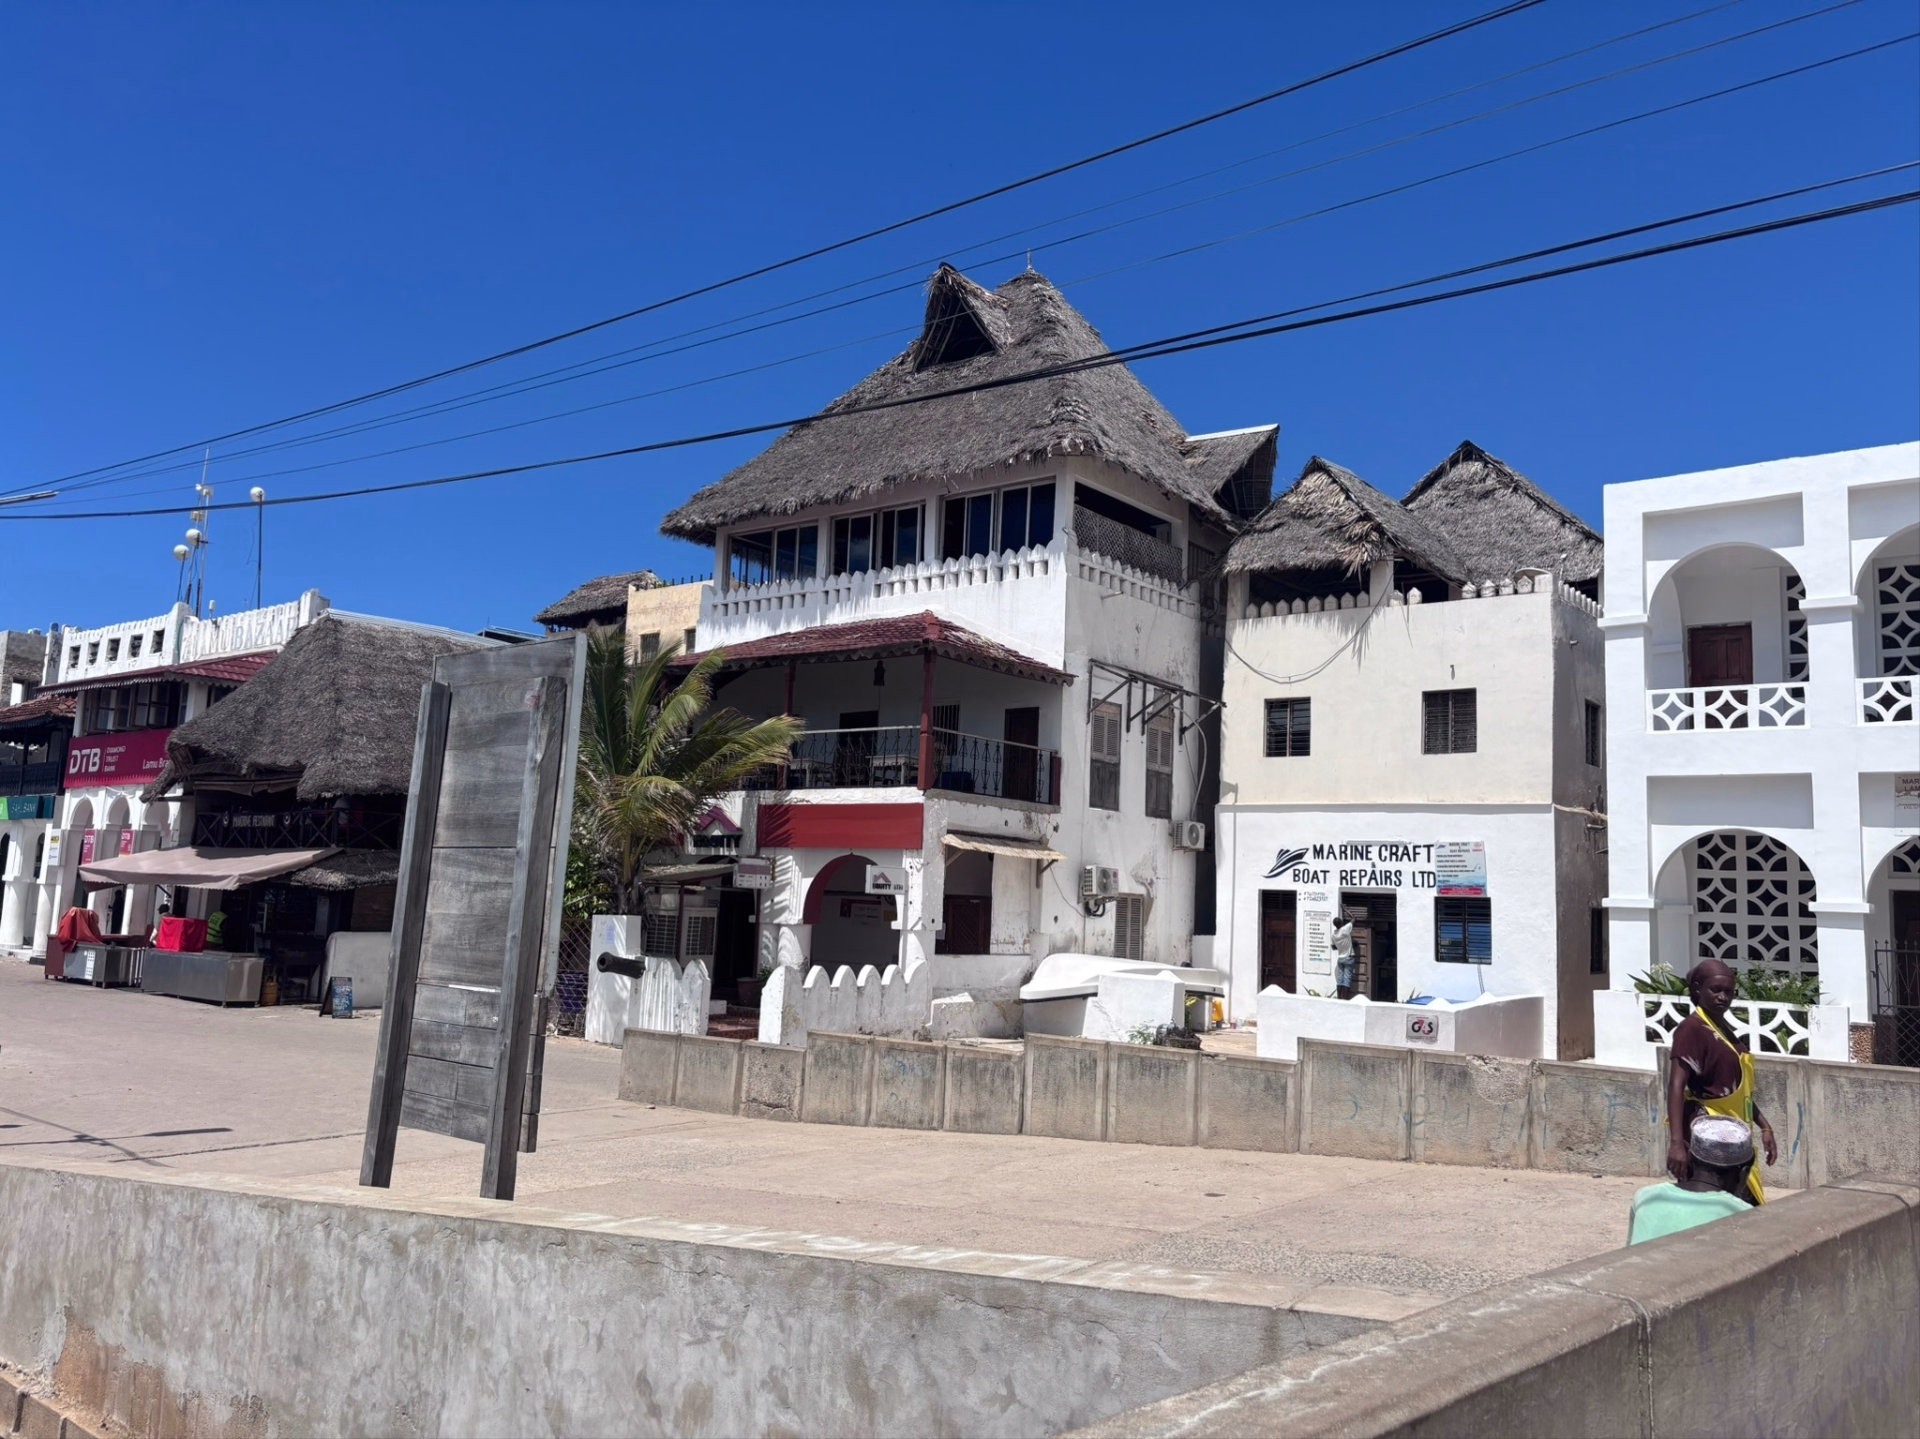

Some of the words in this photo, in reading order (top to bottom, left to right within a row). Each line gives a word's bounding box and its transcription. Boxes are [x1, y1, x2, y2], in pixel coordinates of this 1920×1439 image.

[106, 746, 126, 754] DIAMOND
[69, 748, 101, 774] DTB
[106, 755, 119, 763] TRUST
[142, 759, 158, 770] Lamu
[1312, 843, 1373, 861] MARINE
[1378, 843, 1434, 863] CRAFT
[1293, 868, 1330, 884] BOAT
[1339, 869, 1402, 887] REPAIRS
[1412, 871, 1436, 888] LTD
